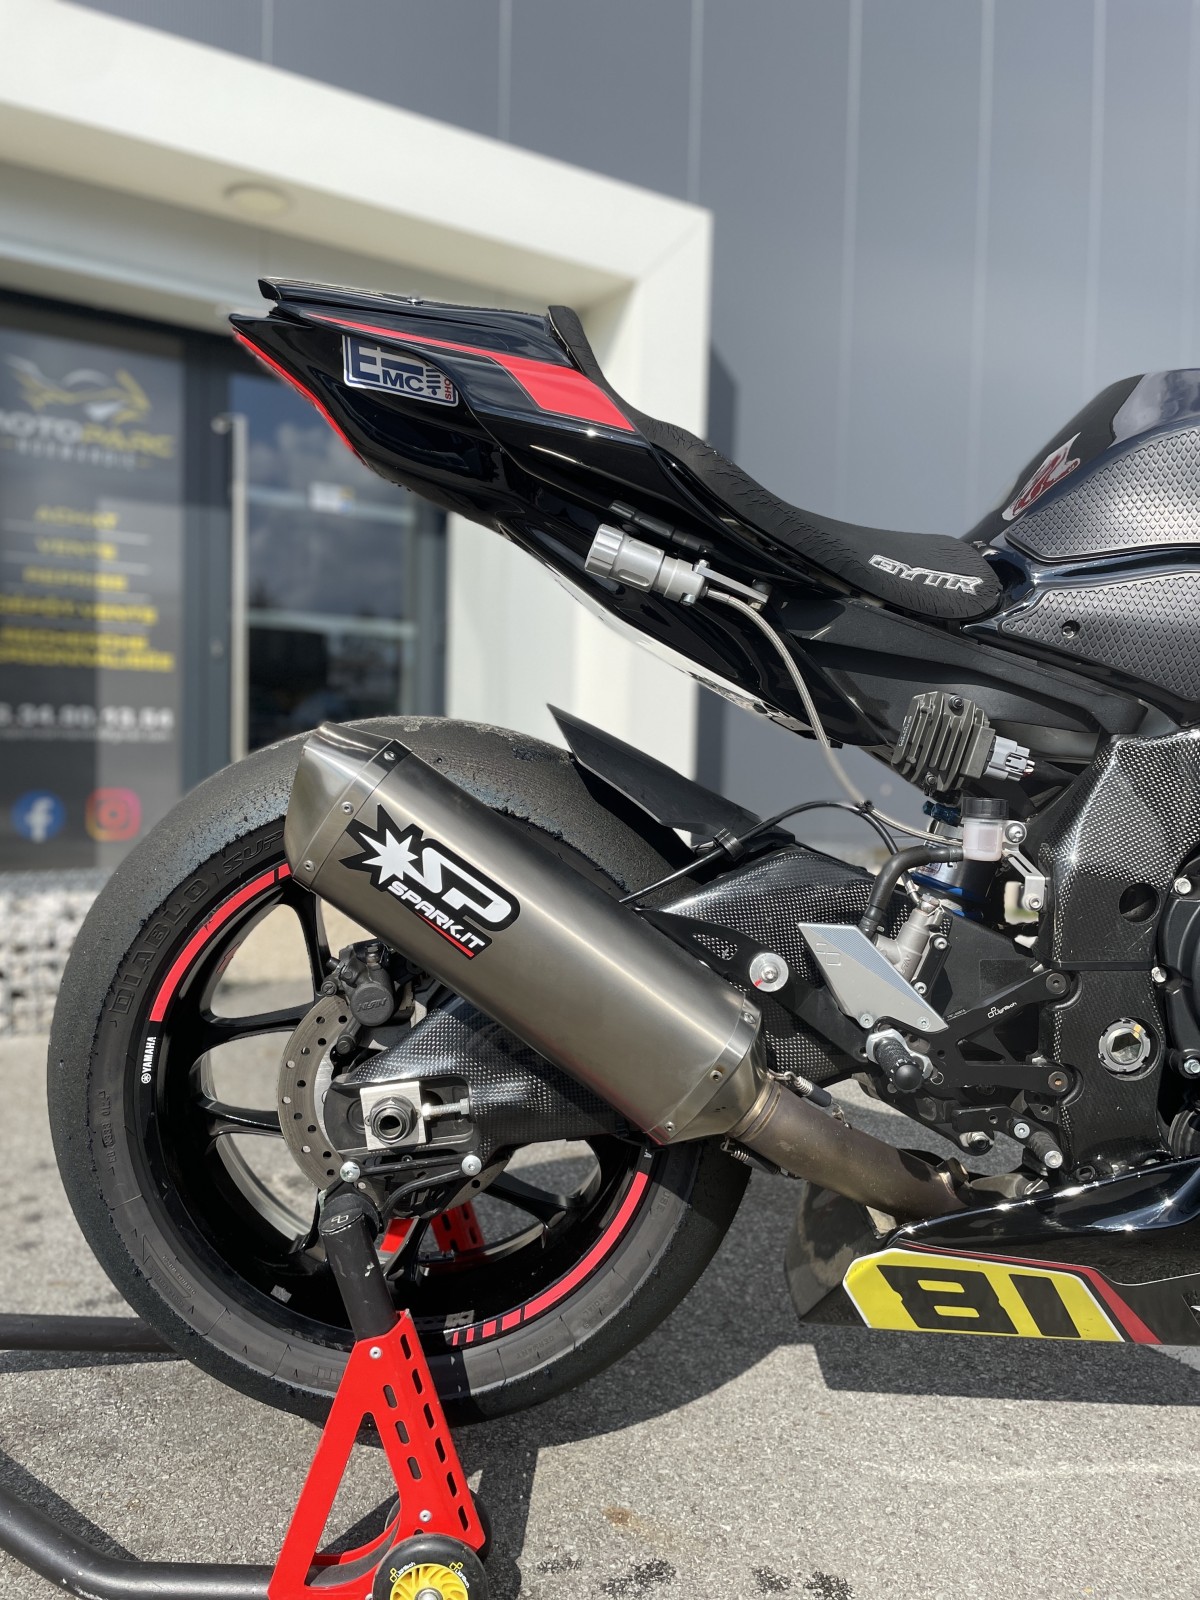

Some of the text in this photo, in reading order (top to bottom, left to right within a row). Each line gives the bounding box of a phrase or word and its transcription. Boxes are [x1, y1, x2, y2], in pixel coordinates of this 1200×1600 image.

[868, 554, 984, 595] GYTR
[109, 878, 210, 1015] DIABLO
[387, 880, 486, 949] SPARK.IT
[142, 1036, 157, 1074] YAMAHA
[876, 1264, 1082, 1339] 81
